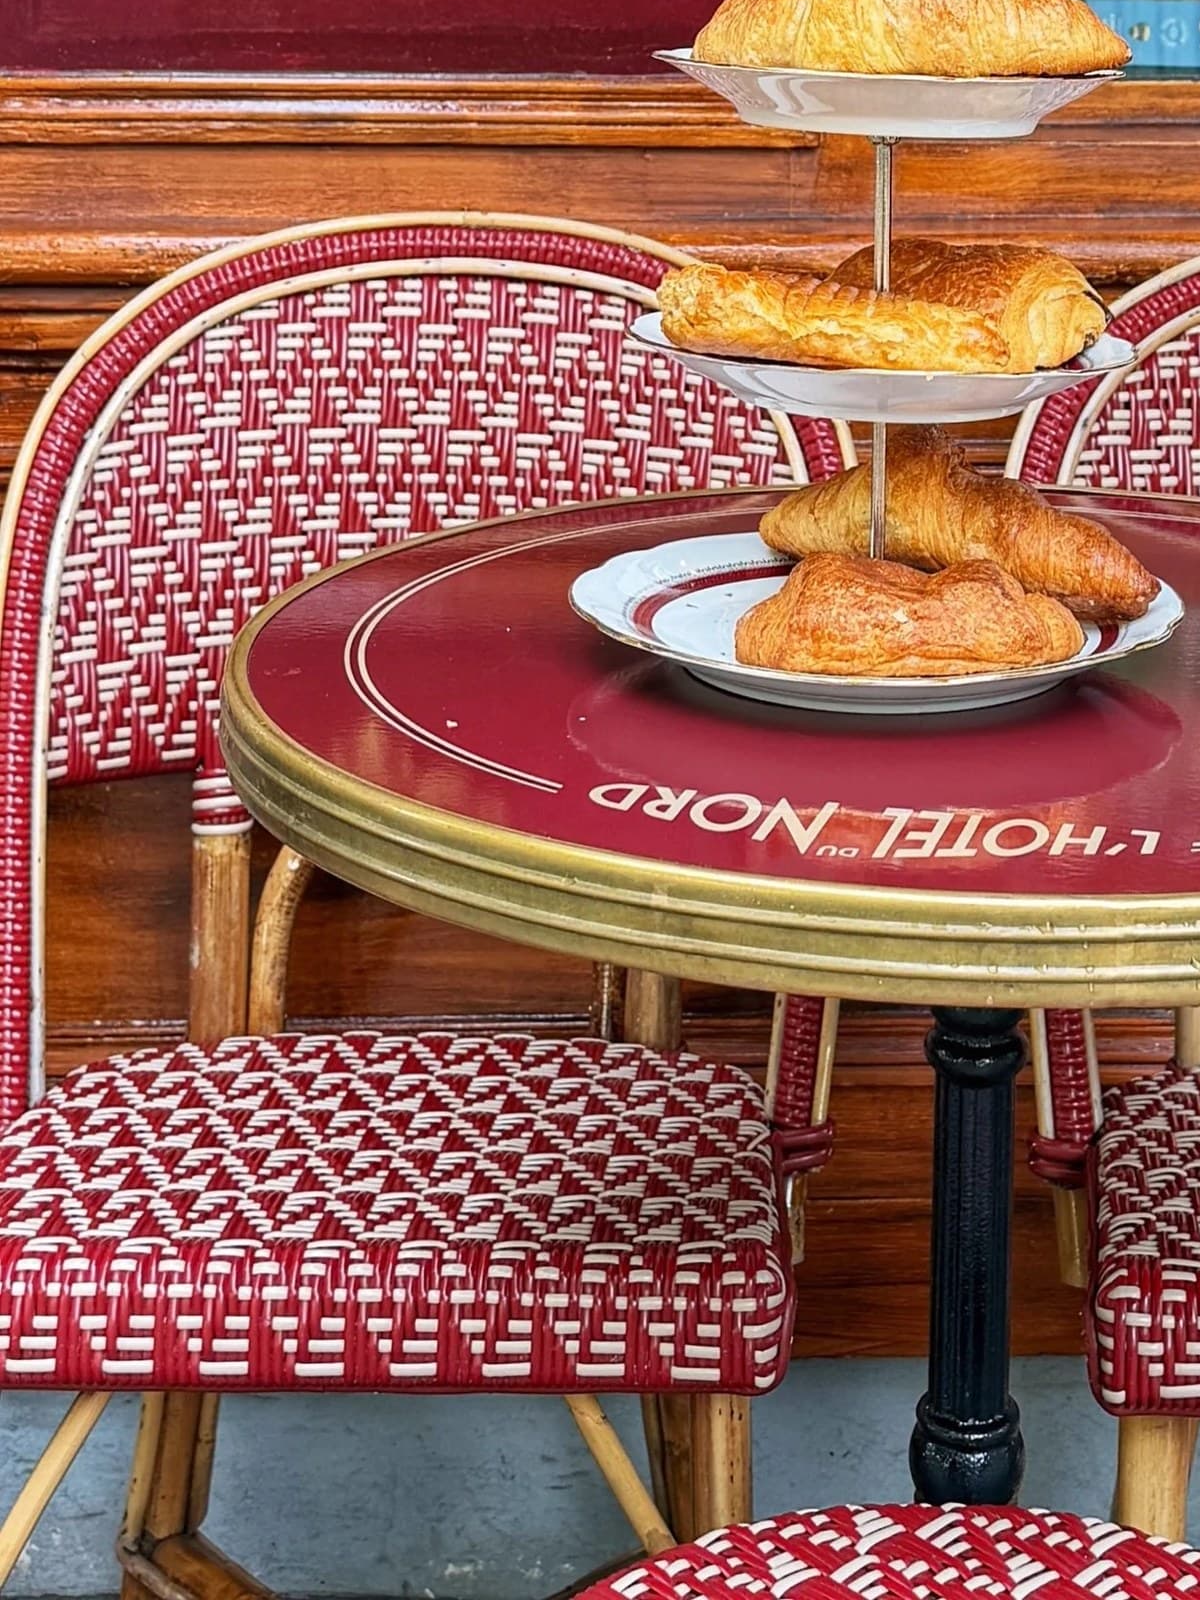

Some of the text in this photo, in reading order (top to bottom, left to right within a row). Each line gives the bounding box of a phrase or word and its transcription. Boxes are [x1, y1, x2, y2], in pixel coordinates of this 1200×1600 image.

[587, 783, 1162, 859] L'HOTEL DU NORD
